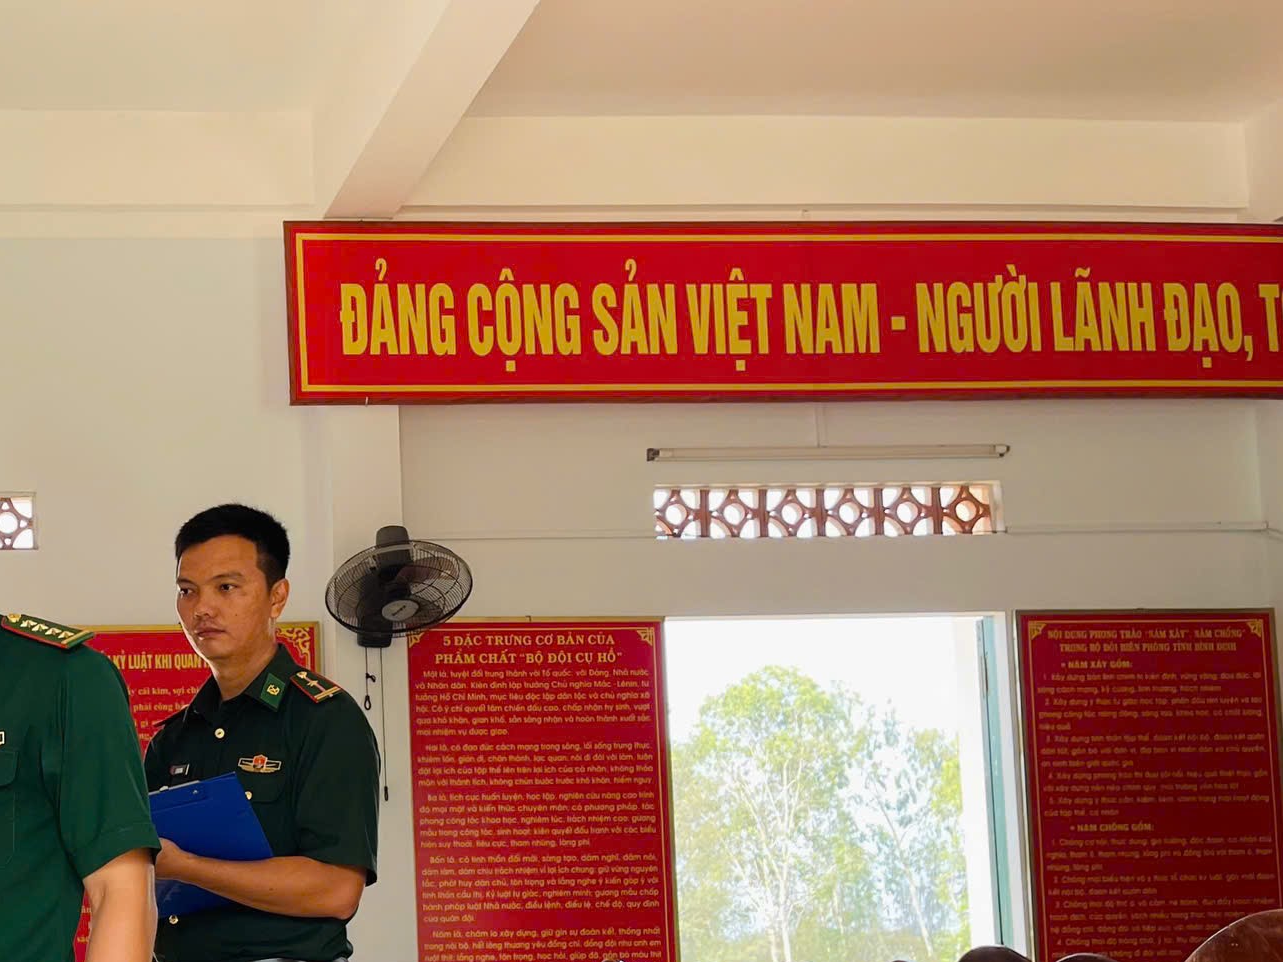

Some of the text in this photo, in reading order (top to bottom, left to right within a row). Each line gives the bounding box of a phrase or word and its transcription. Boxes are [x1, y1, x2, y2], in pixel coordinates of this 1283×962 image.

[340, 258, 455, 356] ĐẢNG
[467, 268, 581, 372] CỘNG
[592, 258, 679, 355] SẢN
[689, 268, 771, 372] VIỆT
[784, 282, 881, 354] NAM
[917, 264, 1041, 354] NGƯỜI
[1053, 269, 1157, 352] LÃNH
[1164, 282, 1254, 368] ĐẠO,
[443, 631, 615, 648] 5 ĐẶC TRƯNG CƠ BẢN CỦA
[128, 651, 153, 672] LUẬT
[155, 654, 172, 669] KHI
[435, 648, 475, 664] PHẨM
[479, 648, 516, 664] CHẤT
[547, 649, 572, 665] ĐỘI
[576, 652, 593, 666] CỤ
